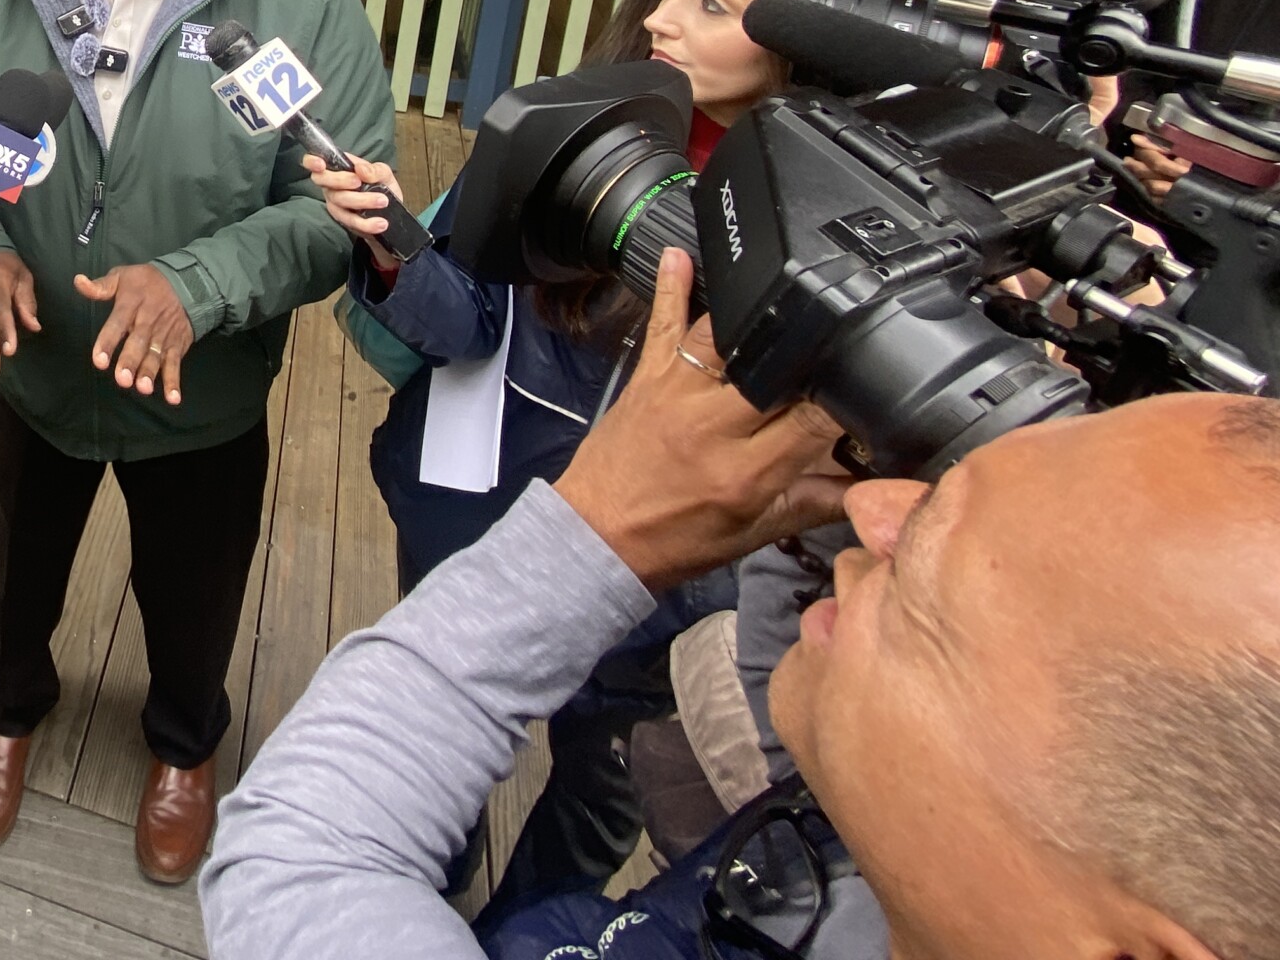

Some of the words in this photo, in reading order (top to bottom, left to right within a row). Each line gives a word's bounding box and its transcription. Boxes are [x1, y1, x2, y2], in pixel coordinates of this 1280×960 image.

[242, 47, 284, 84] news
[218, 82, 240, 100] news
[256, 62, 313, 114] 12
[230, 95, 269, 131] 12
[613, 221, 630, 251] FUJINON
[626, 199, 647, 222] SUPER
[644, 184, 663, 200] WIDE
[660, 178, 672, 187] TV
